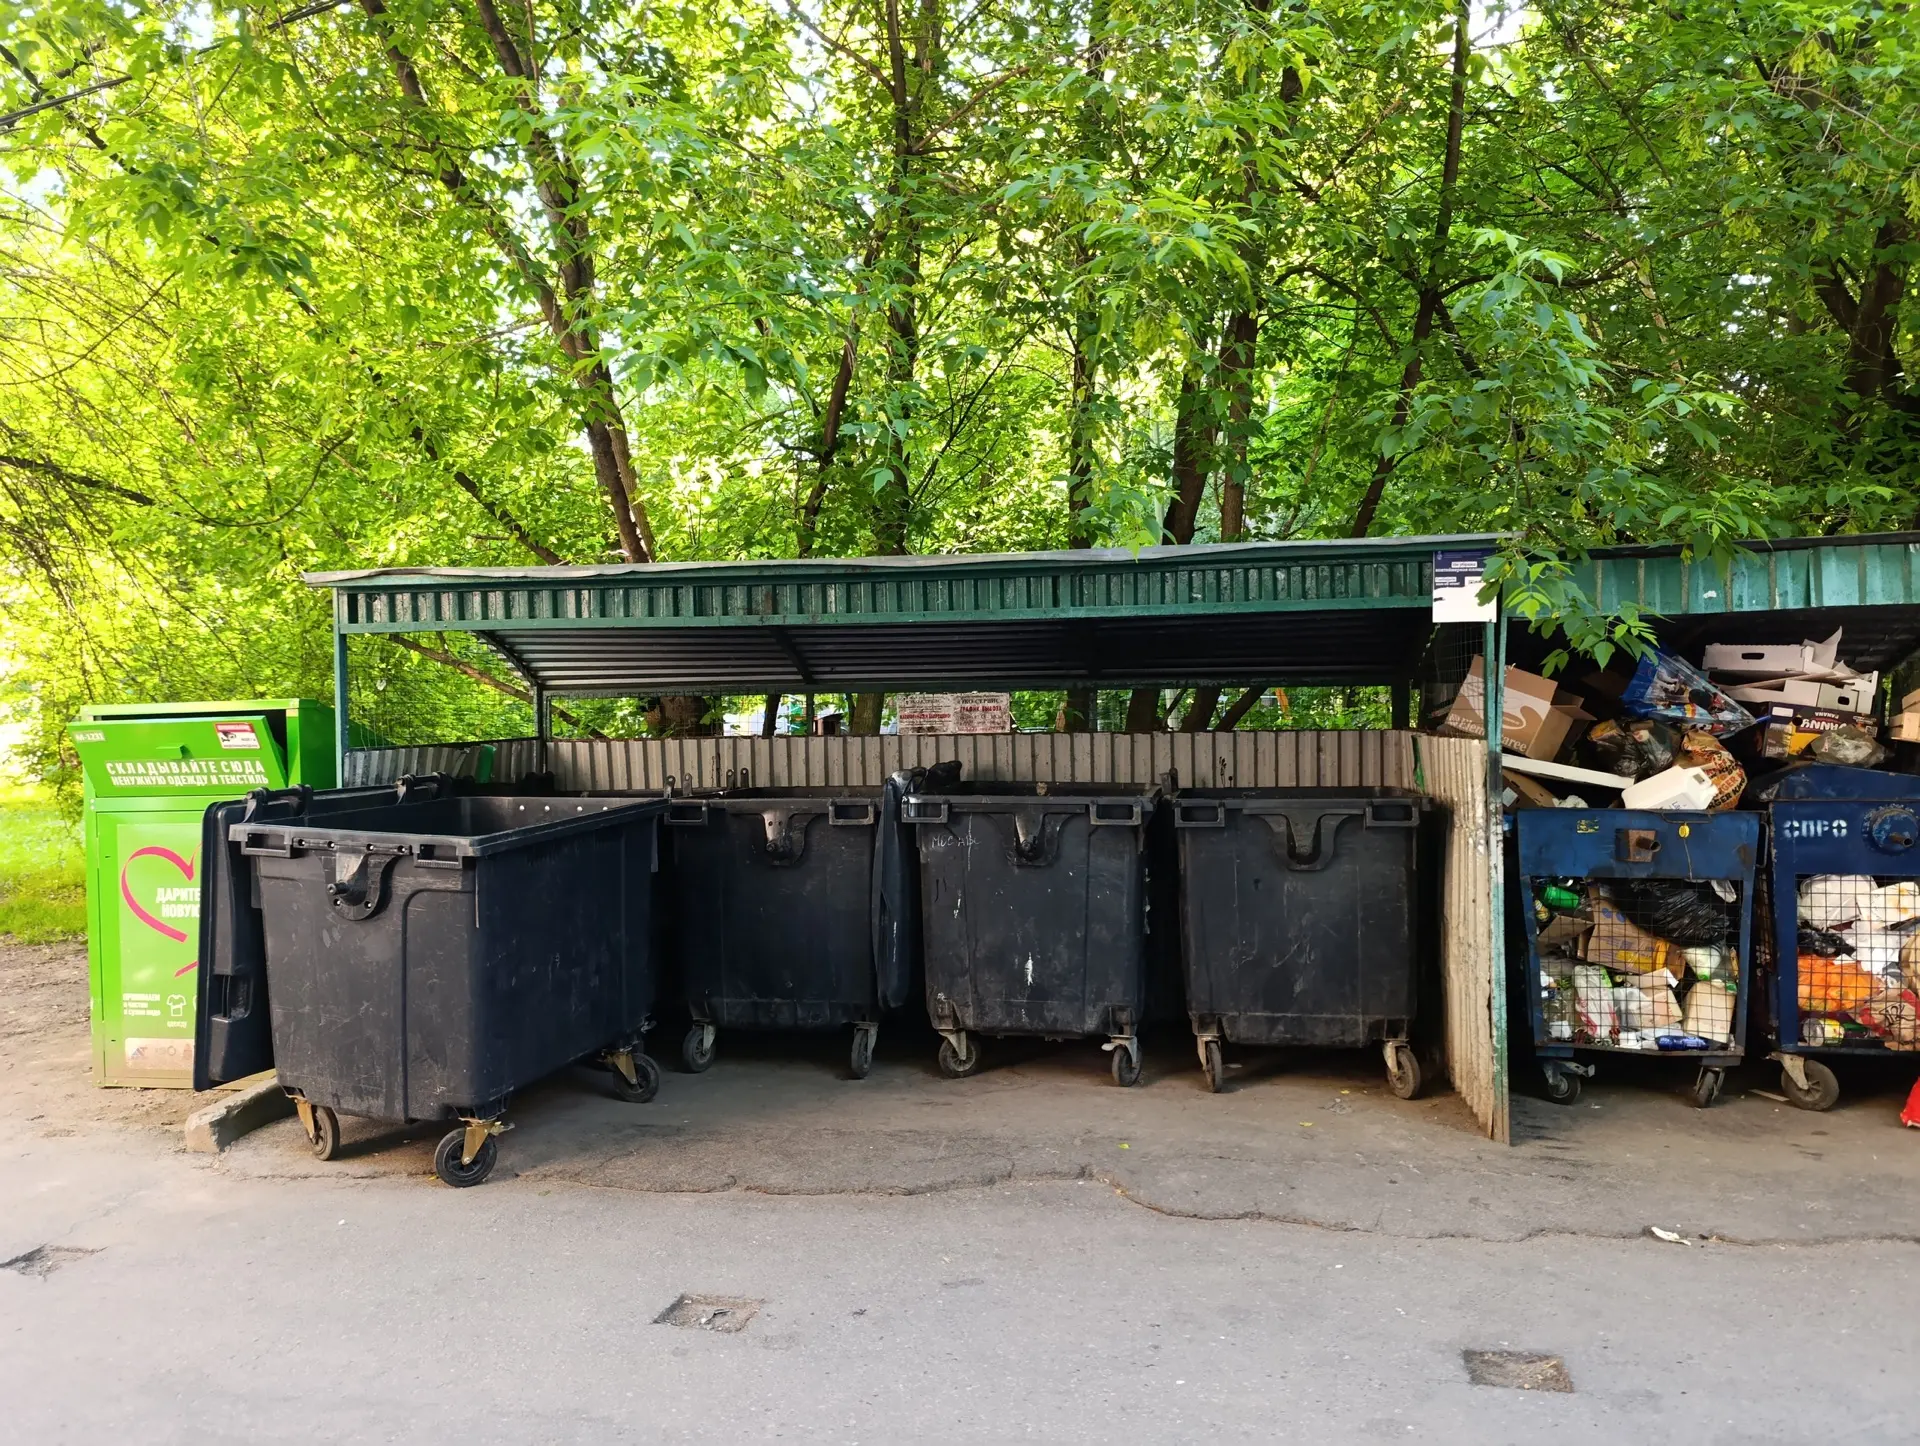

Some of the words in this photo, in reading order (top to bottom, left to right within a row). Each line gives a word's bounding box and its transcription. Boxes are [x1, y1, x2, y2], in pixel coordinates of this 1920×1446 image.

[105, 760, 218, 776] СКЛАДЫВАЙТЕ
[220, 760, 265, 775] СЮДА
[110, 775, 167, 786] НЕНУЖНУЮ
[166, 775, 208, 786] ОДЕЖДУ
[210, 775, 219, 785] И
[218, 774, 269, 785] ТЕКСТИЛЬ
[155, 887, 201, 904] ДАРИТЕ
